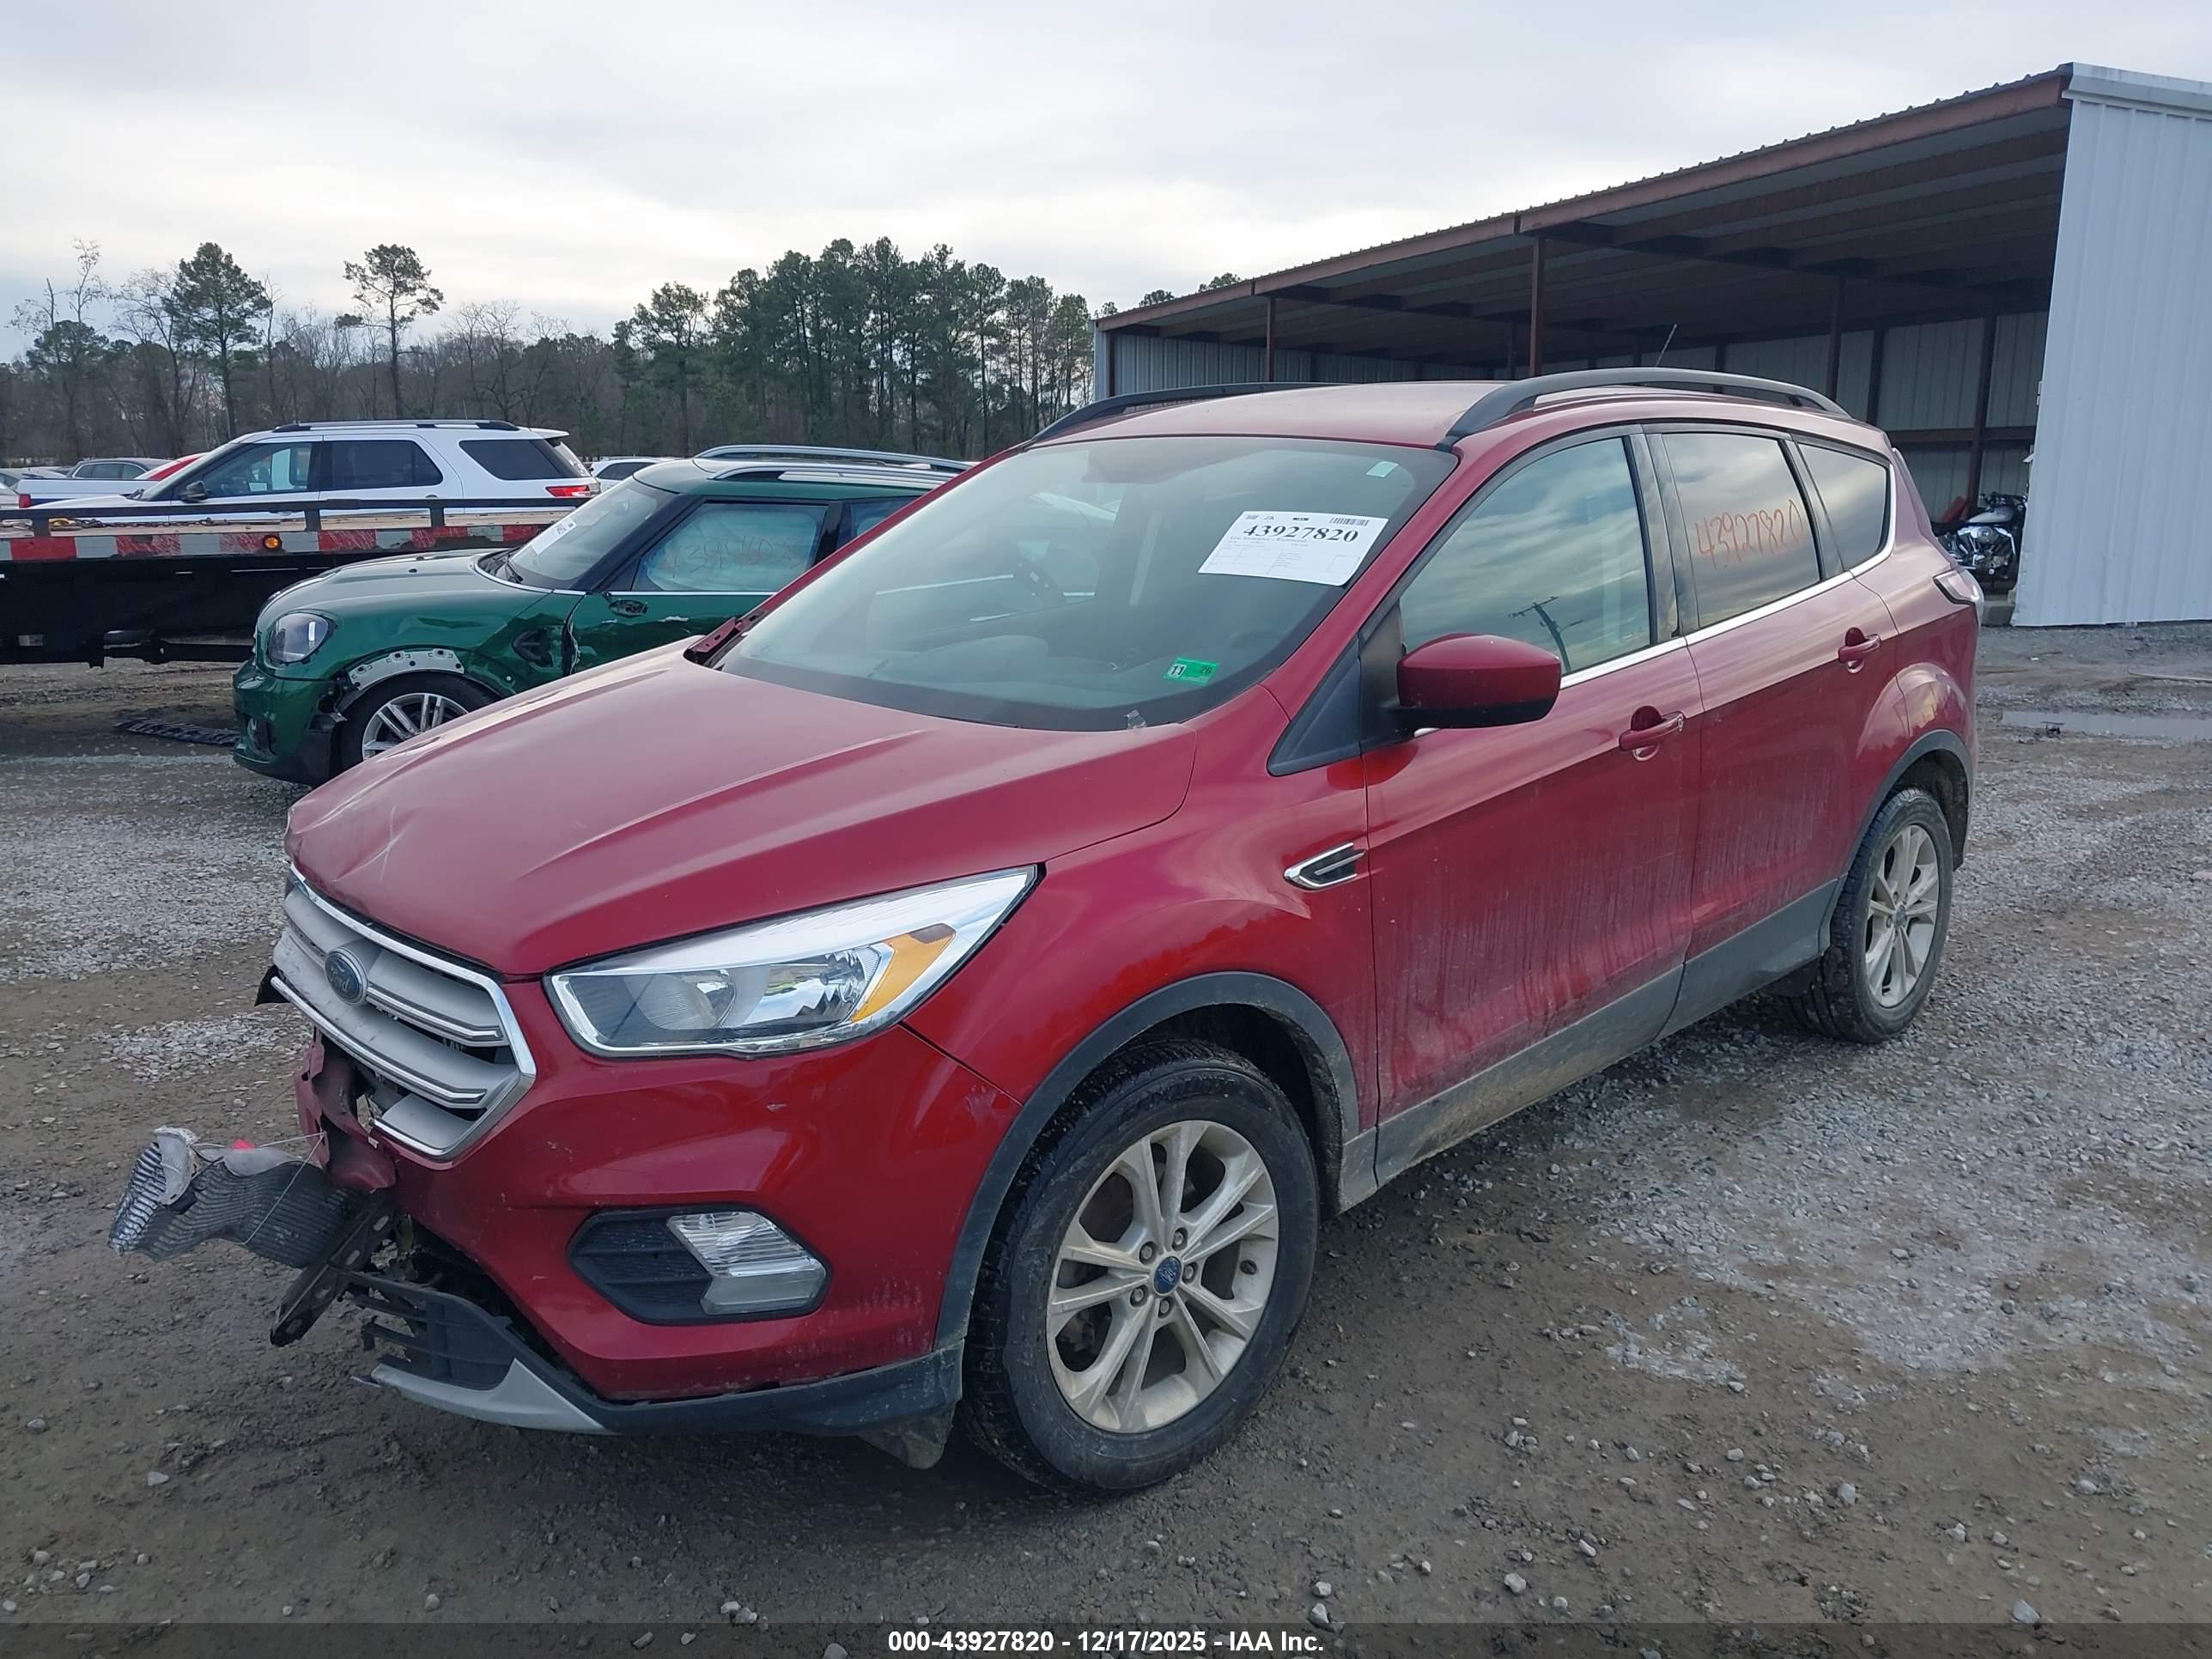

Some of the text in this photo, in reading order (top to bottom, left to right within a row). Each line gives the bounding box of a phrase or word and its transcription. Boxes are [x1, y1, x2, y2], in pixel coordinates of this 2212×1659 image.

[1243, 524, 1359, 543] 43927820
[1694, 498, 1802, 568] 43927820
[1170, 665, 1186, 676] 11
